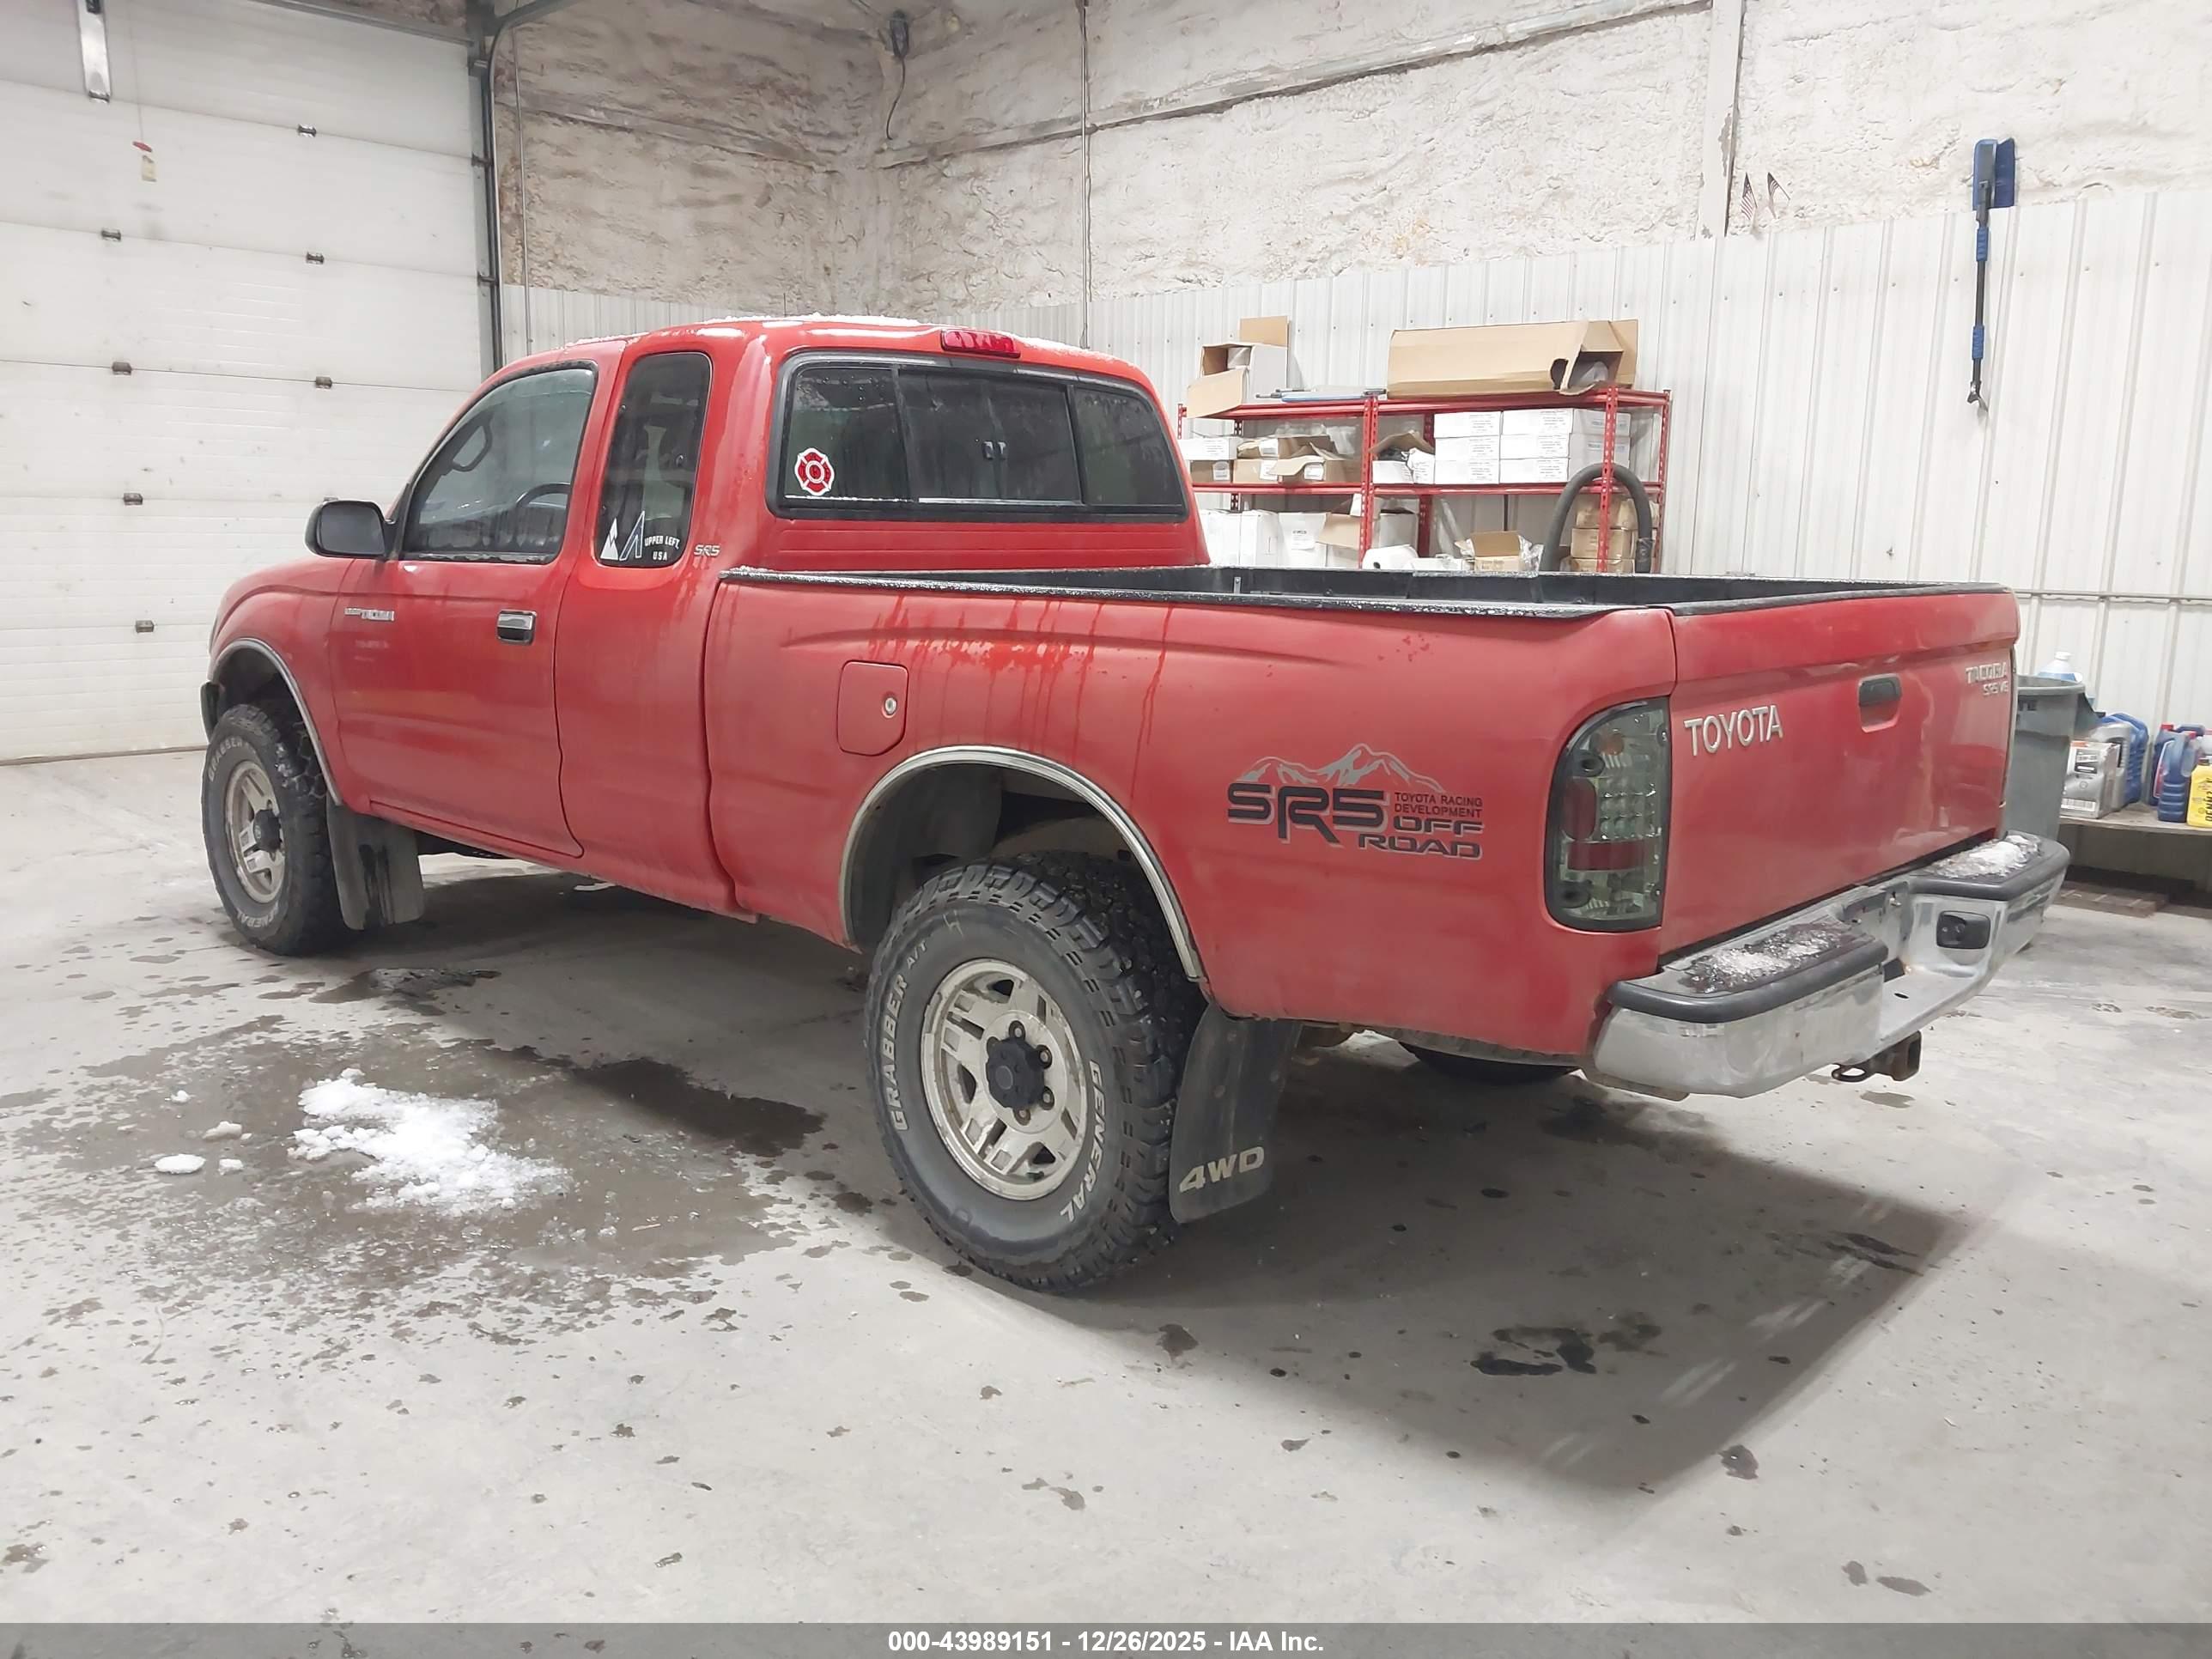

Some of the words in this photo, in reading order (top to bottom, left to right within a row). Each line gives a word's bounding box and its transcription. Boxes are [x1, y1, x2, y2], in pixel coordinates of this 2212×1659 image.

[644, 535, 664, 547] UPPER
[694, 544, 720, 556] SR5
[653, 551, 668, 561] USA
[1683, 704, 1784, 757] TOYOTA
[1394, 802, 1483, 818] DEVELOPMENT
[1395, 791, 1437, 805] TOYOTA
[1440, 794, 1483, 807] RACING
[1228, 782, 1388, 847] SR5
[1393, 815, 1485, 838] OFF
[1358, 833, 1483, 860] ROAD
[880, 974, 909, 1132] GRABBER
[906, 940, 927, 970] A/T
[1059, 1059, 1106, 1223] GENERAL
[1178, 1146, 1266, 1194] 4WD
